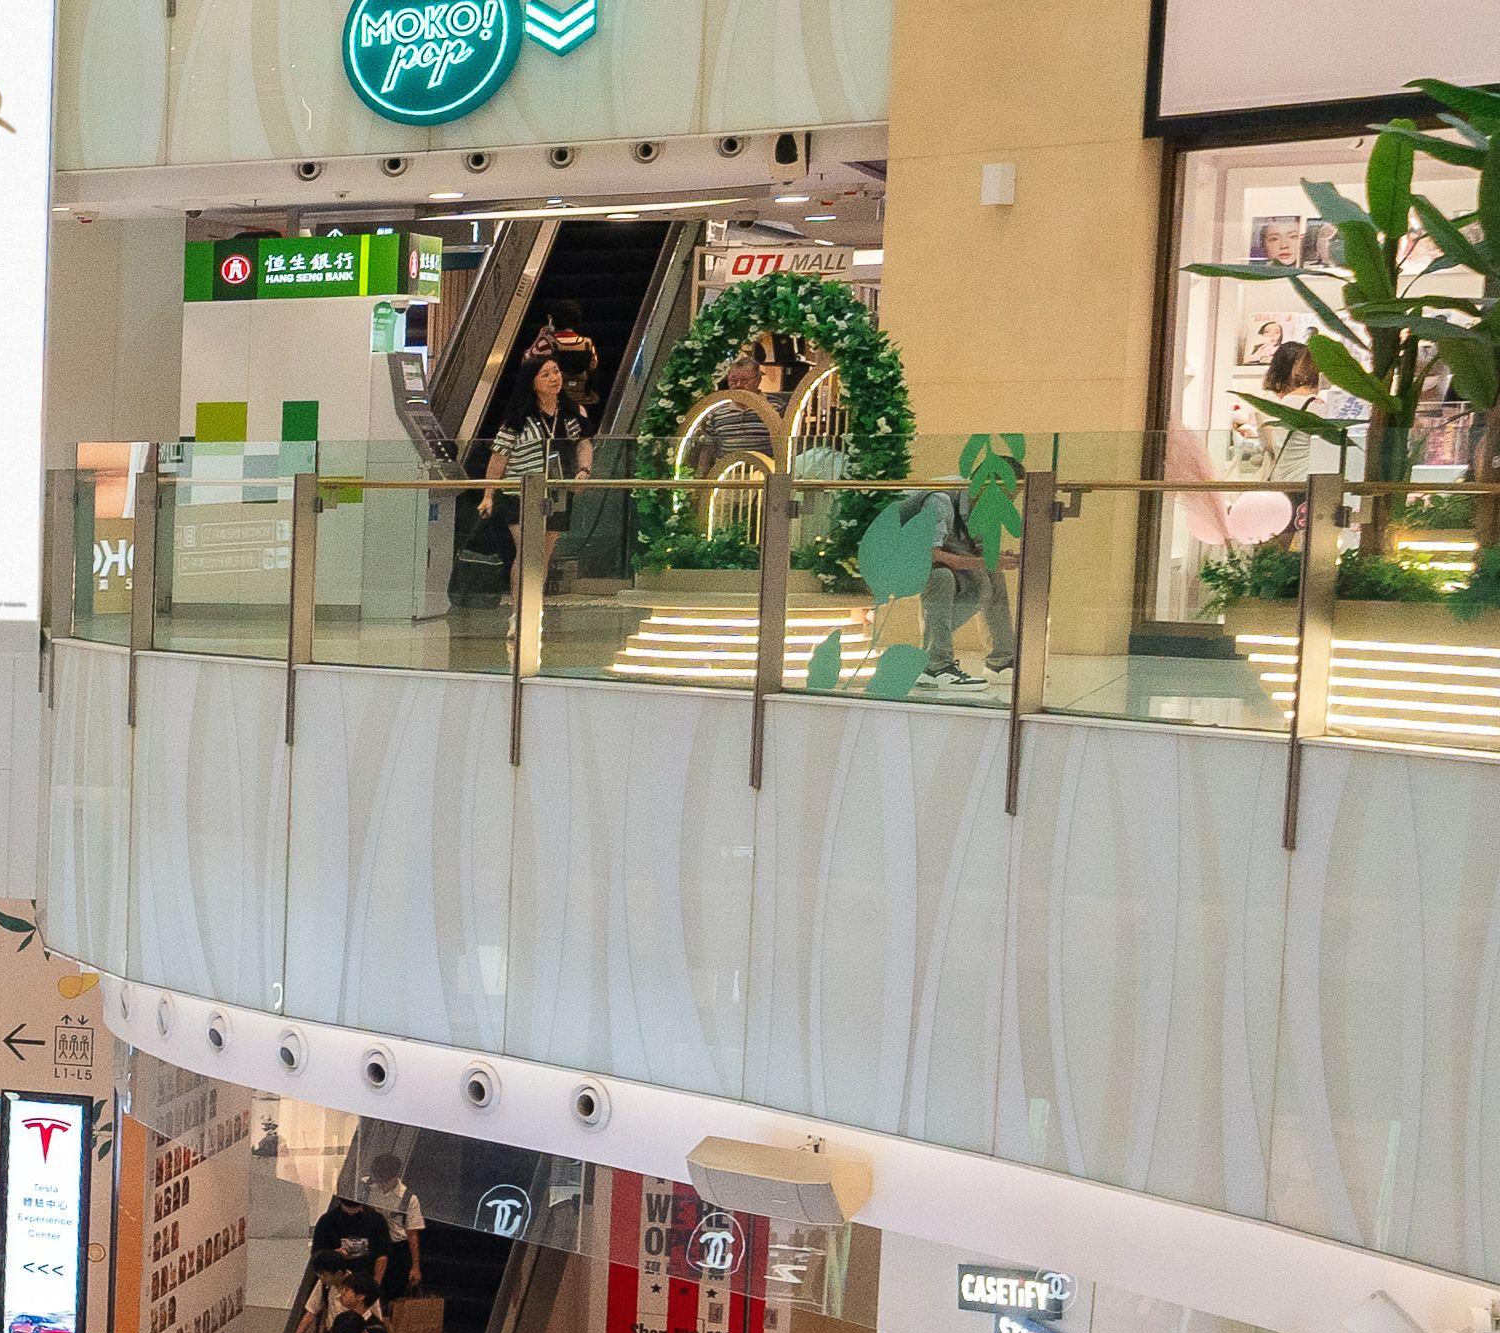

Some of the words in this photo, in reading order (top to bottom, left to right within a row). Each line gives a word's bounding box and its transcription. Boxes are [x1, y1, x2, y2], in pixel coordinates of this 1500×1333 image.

[380, 39, 476, 94] pop
[792, 252, 848, 271] MALL
[265, 274, 293, 283] HANG
[296, 273, 323, 282] SENG
[325, 272, 354, 281] BANK
[54, 1066, 93, 1081] L1-L5
[34, 1184, 59, 1193] Tesla
[17, 1213, 72, 1226] Experience
[28, 1230, 60, 1240] Center
